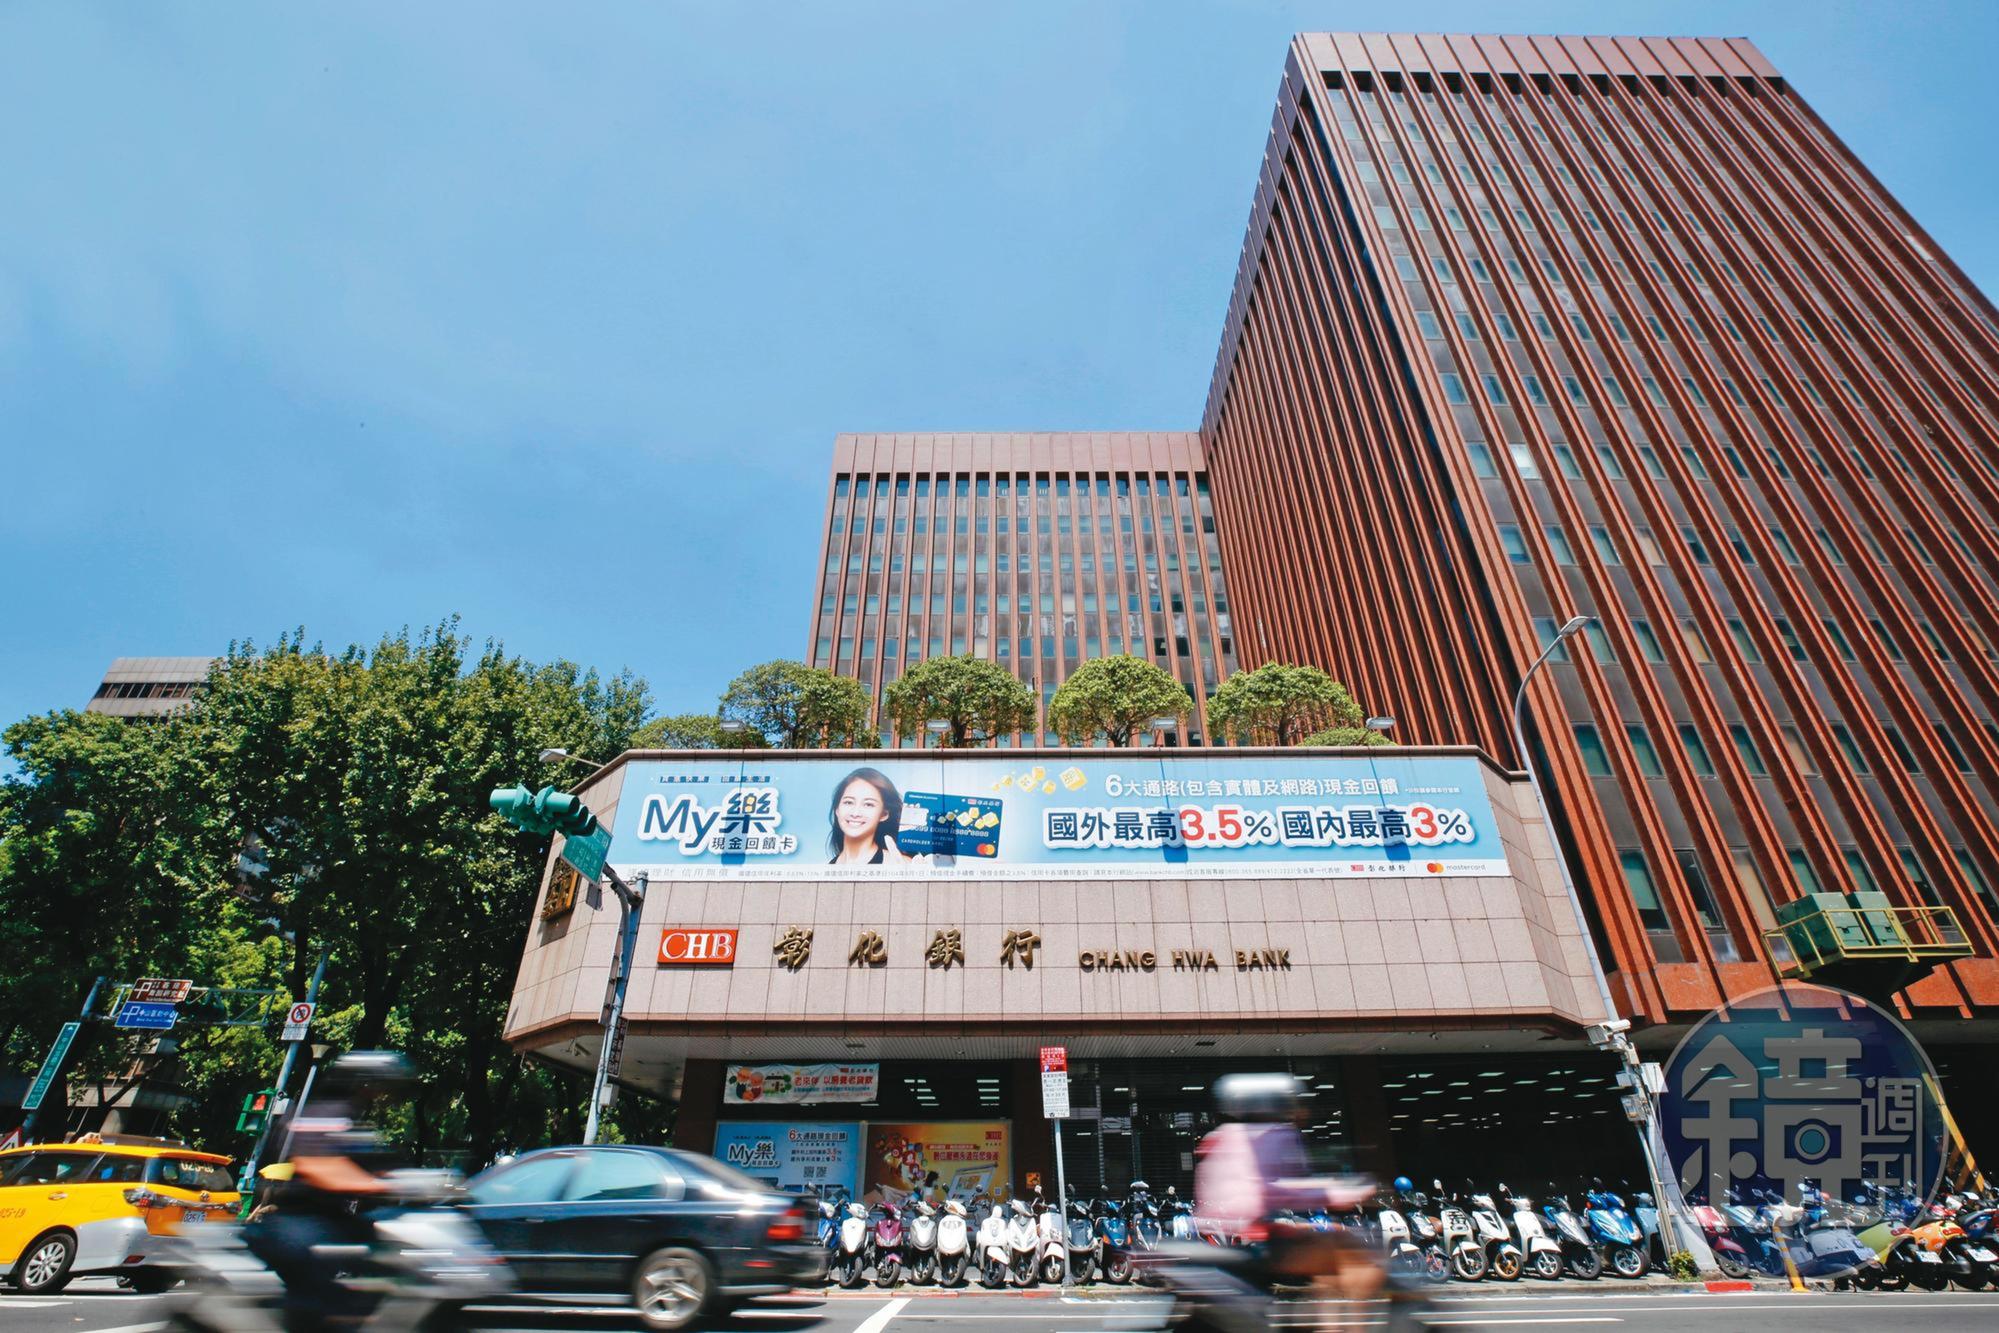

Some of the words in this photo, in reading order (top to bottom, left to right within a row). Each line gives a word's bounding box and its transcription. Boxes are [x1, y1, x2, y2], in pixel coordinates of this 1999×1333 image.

[1047, 808, 1273, 842] 國外最高3.5%
[1281, 806, 1467, 840] 國內最高3%
[711, 836, 794, 851] 現金回饋卡
[661, 931, 734, 960] CHB
[773, 924, 1041, 974] 彰化銀行
[1079, 949, 1157, 973] CHANG
[1171, 949, 1219, 973] HWA
[1235, 948, 1292, 972] BANK
